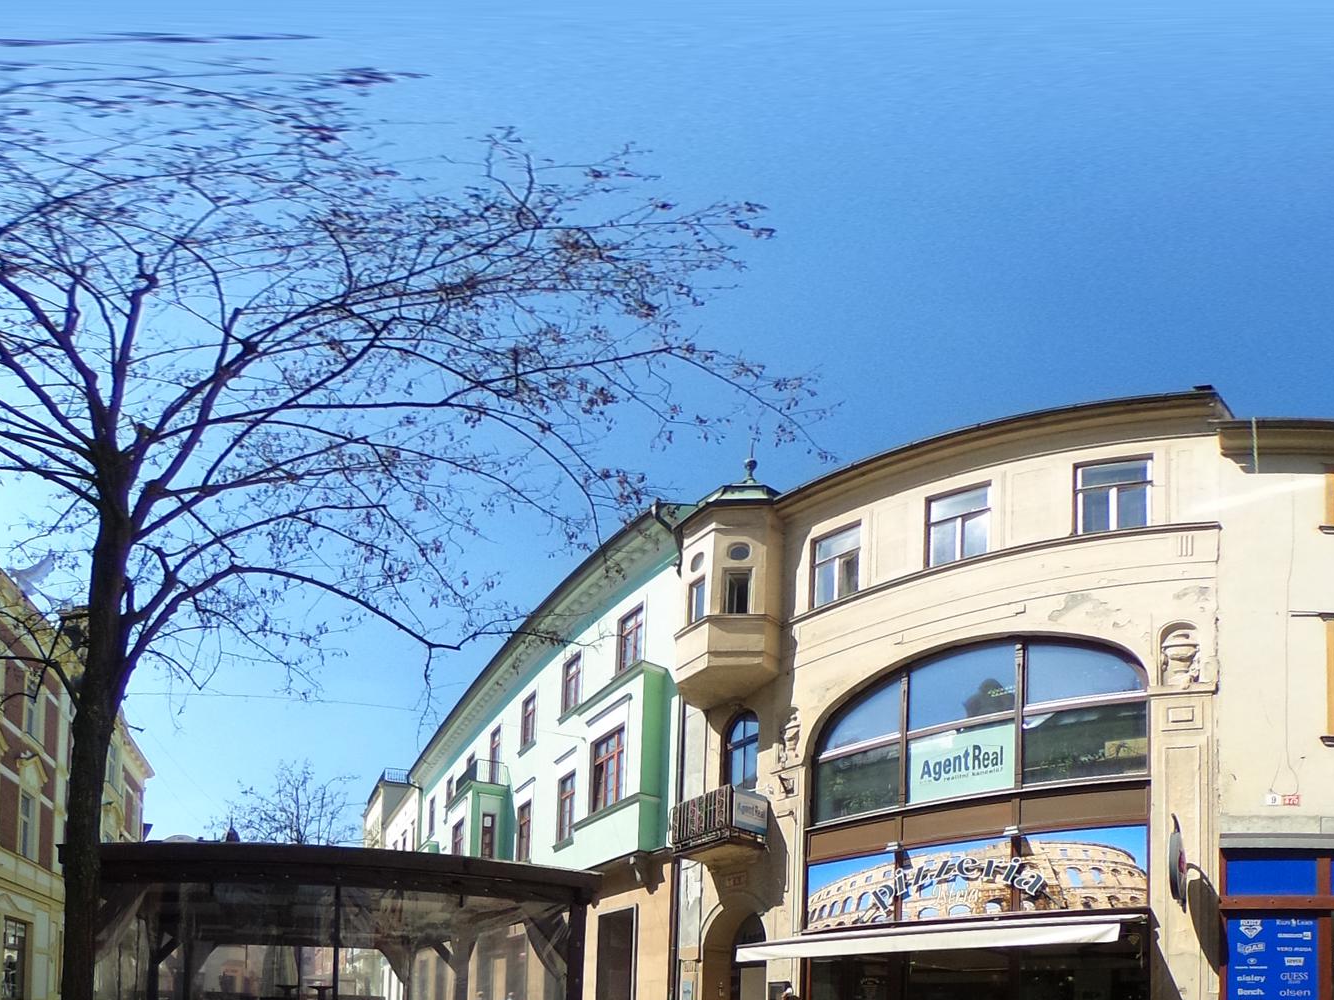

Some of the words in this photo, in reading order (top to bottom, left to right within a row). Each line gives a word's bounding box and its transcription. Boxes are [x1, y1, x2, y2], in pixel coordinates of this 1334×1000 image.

[870, 856, 1045, 915] pizzeria
[1280, 971, 1308, 981] GUESS
[1279, 988, 1311, 997] olsen
